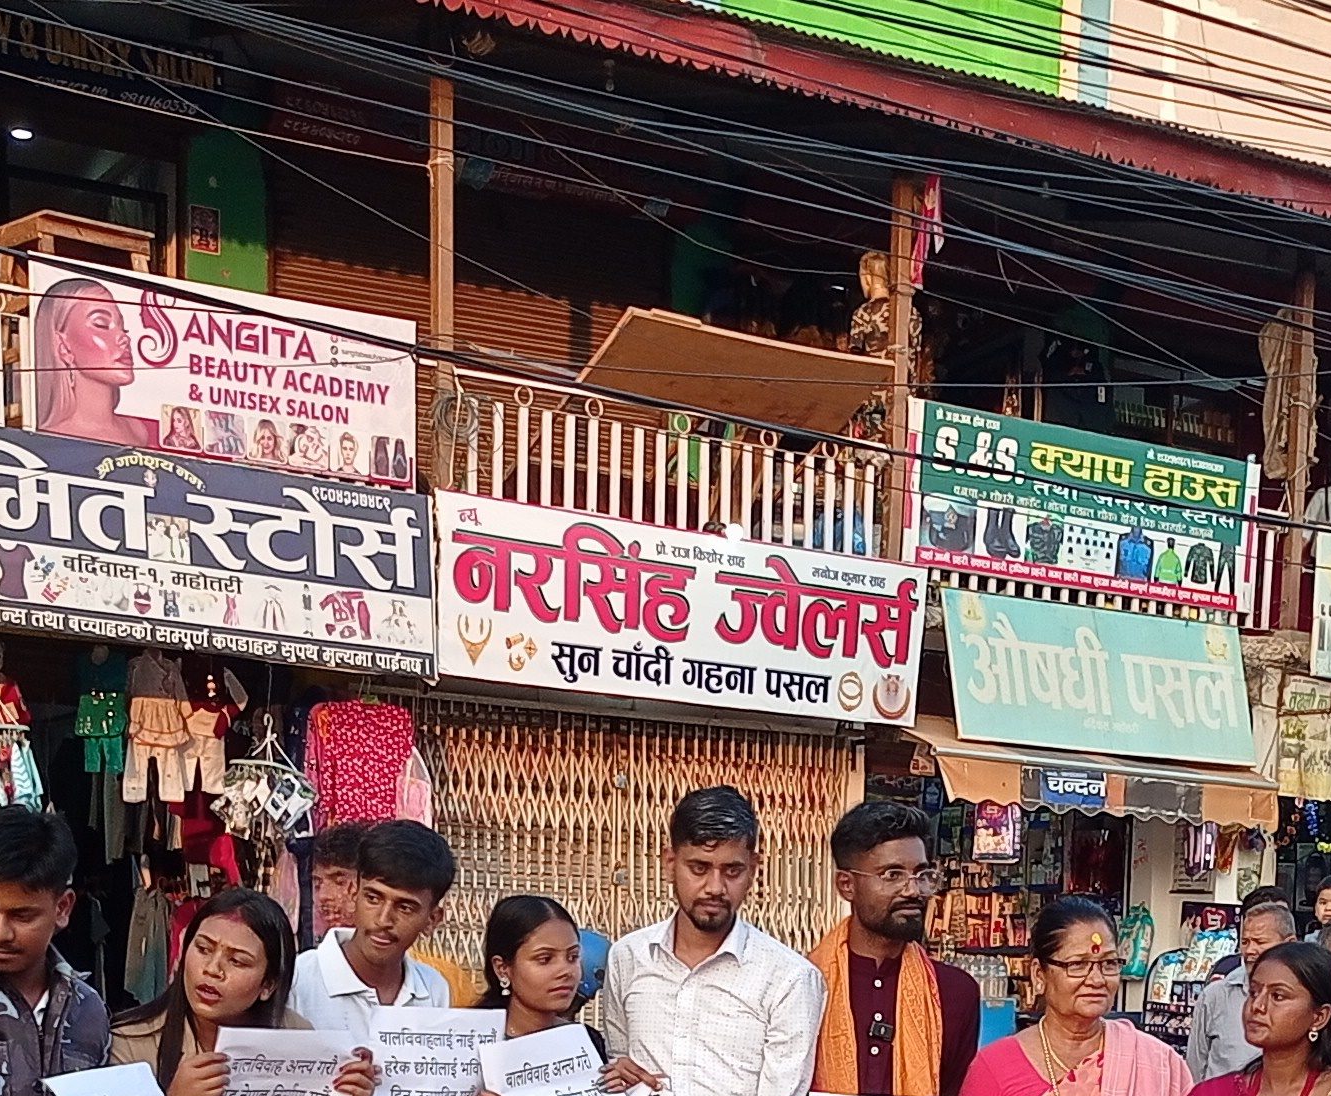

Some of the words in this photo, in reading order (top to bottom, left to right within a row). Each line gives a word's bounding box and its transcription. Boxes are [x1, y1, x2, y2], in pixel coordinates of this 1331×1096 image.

[188, 352, 276, 392] BEAUTY
[281, 367, 391, 406] ACADEMY
[188, 384, 204, 404] &
[207, 387, 281, 415] UNISEX
[285, 397, 350, 425] SALON
[1144, 463, 1242, 508] हाउस
[185, 486, 422, 591] स्टोर्स
[31, 611, 66, 632] तथा
[452, 522, 697, 643] नरसिंह
[715, 554, 920, 671] ज्वेलर्स
[551, 640, 601, 683] सुन
[612, 641, 673, 687] चाँदी
[682, 655, 756, 696] गहना
[766, 668, 832, 704] पसल
[959, 610, 1112, 716] औषधी
[1119, 653, 1239, 730] पसल
[1047, 775, 1106, 797] चन्दन
